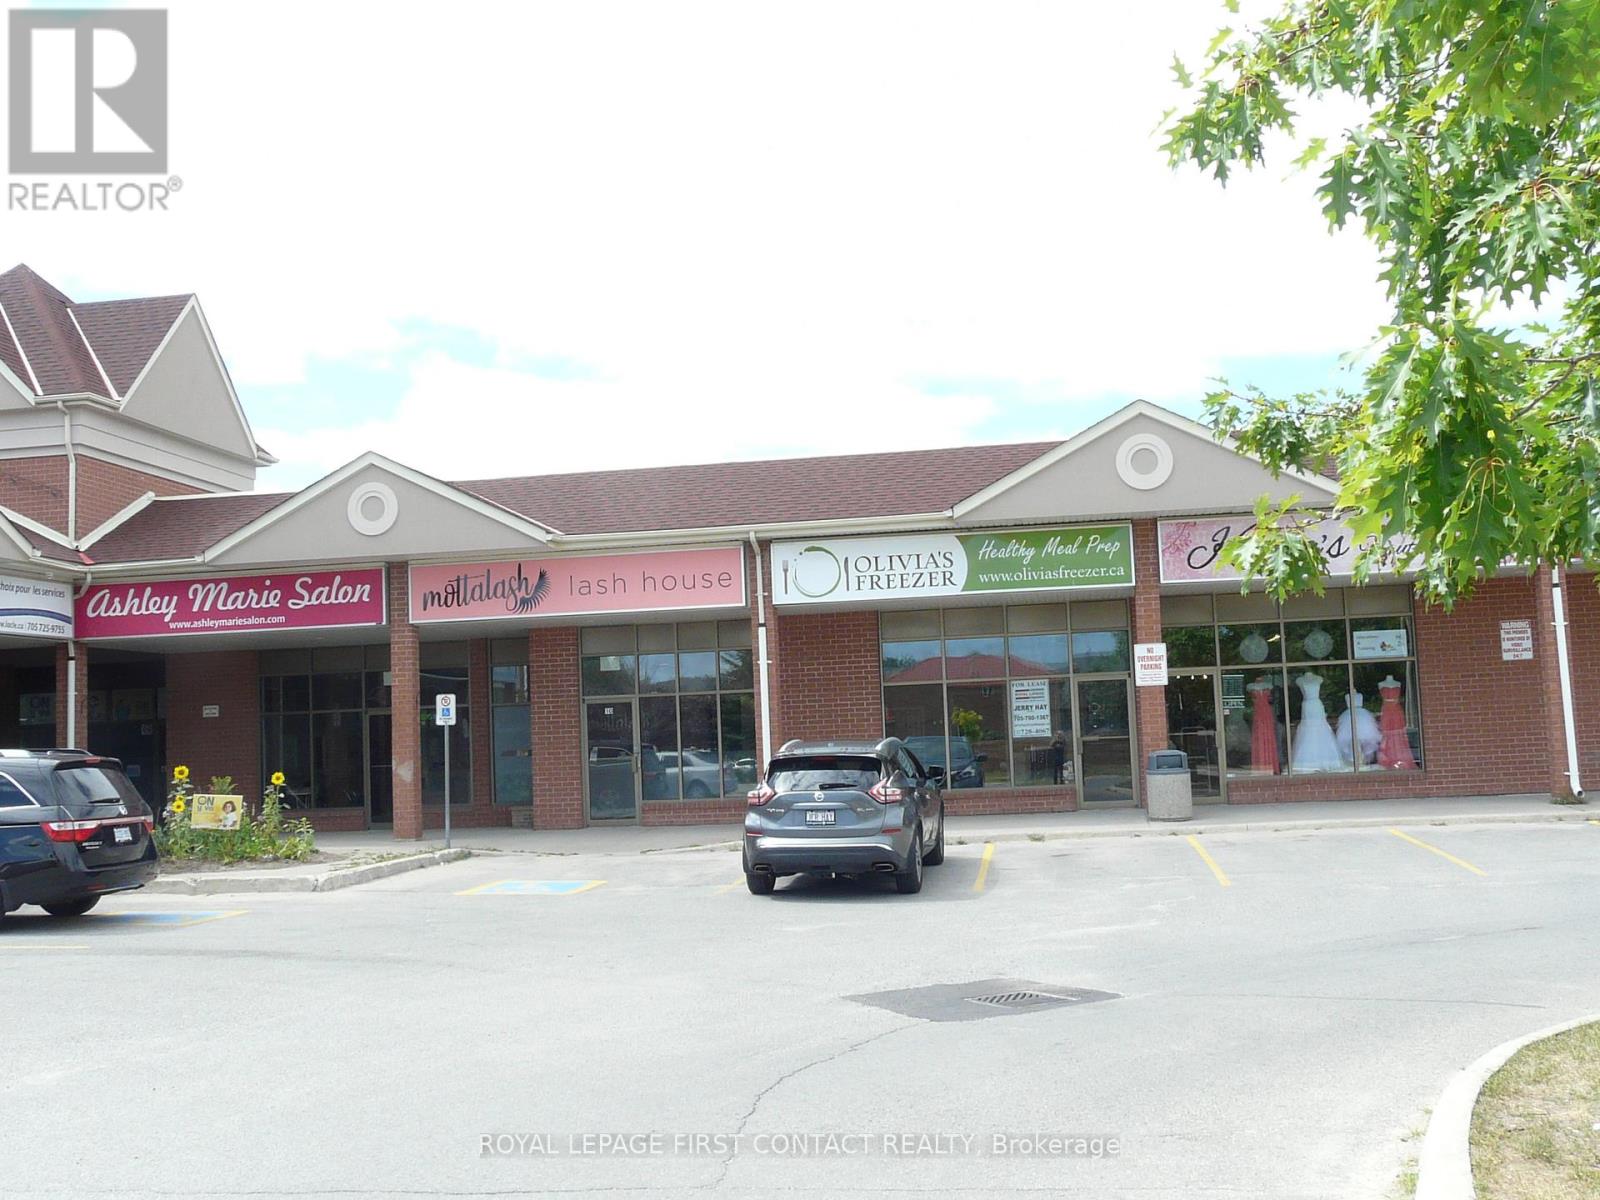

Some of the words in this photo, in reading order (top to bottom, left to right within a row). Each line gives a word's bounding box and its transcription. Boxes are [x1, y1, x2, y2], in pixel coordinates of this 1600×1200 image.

[979, 537, 1036, 565] Healthy
[1041, 536, 1078, 558] Meal
[1086, 535, 1121, 560] Prep
[854, 550, 954, 573] OLIVIA'S
[568, 572, 628, 597] lash
[642, 569, 734, 593] house
[855, 570, 957, 592] FREEZER
[978, 564, 1125, 585] www.oliviasfreezer.ca
[87, 586, 177, 621] Ashley
[188, 580, 281, 611] Marie
[288, 575, 371, 609] Salon
[168, 613, 287, 631] www.ashleymariesalon.com
[1014, 704, 1033, 712] JERRY
